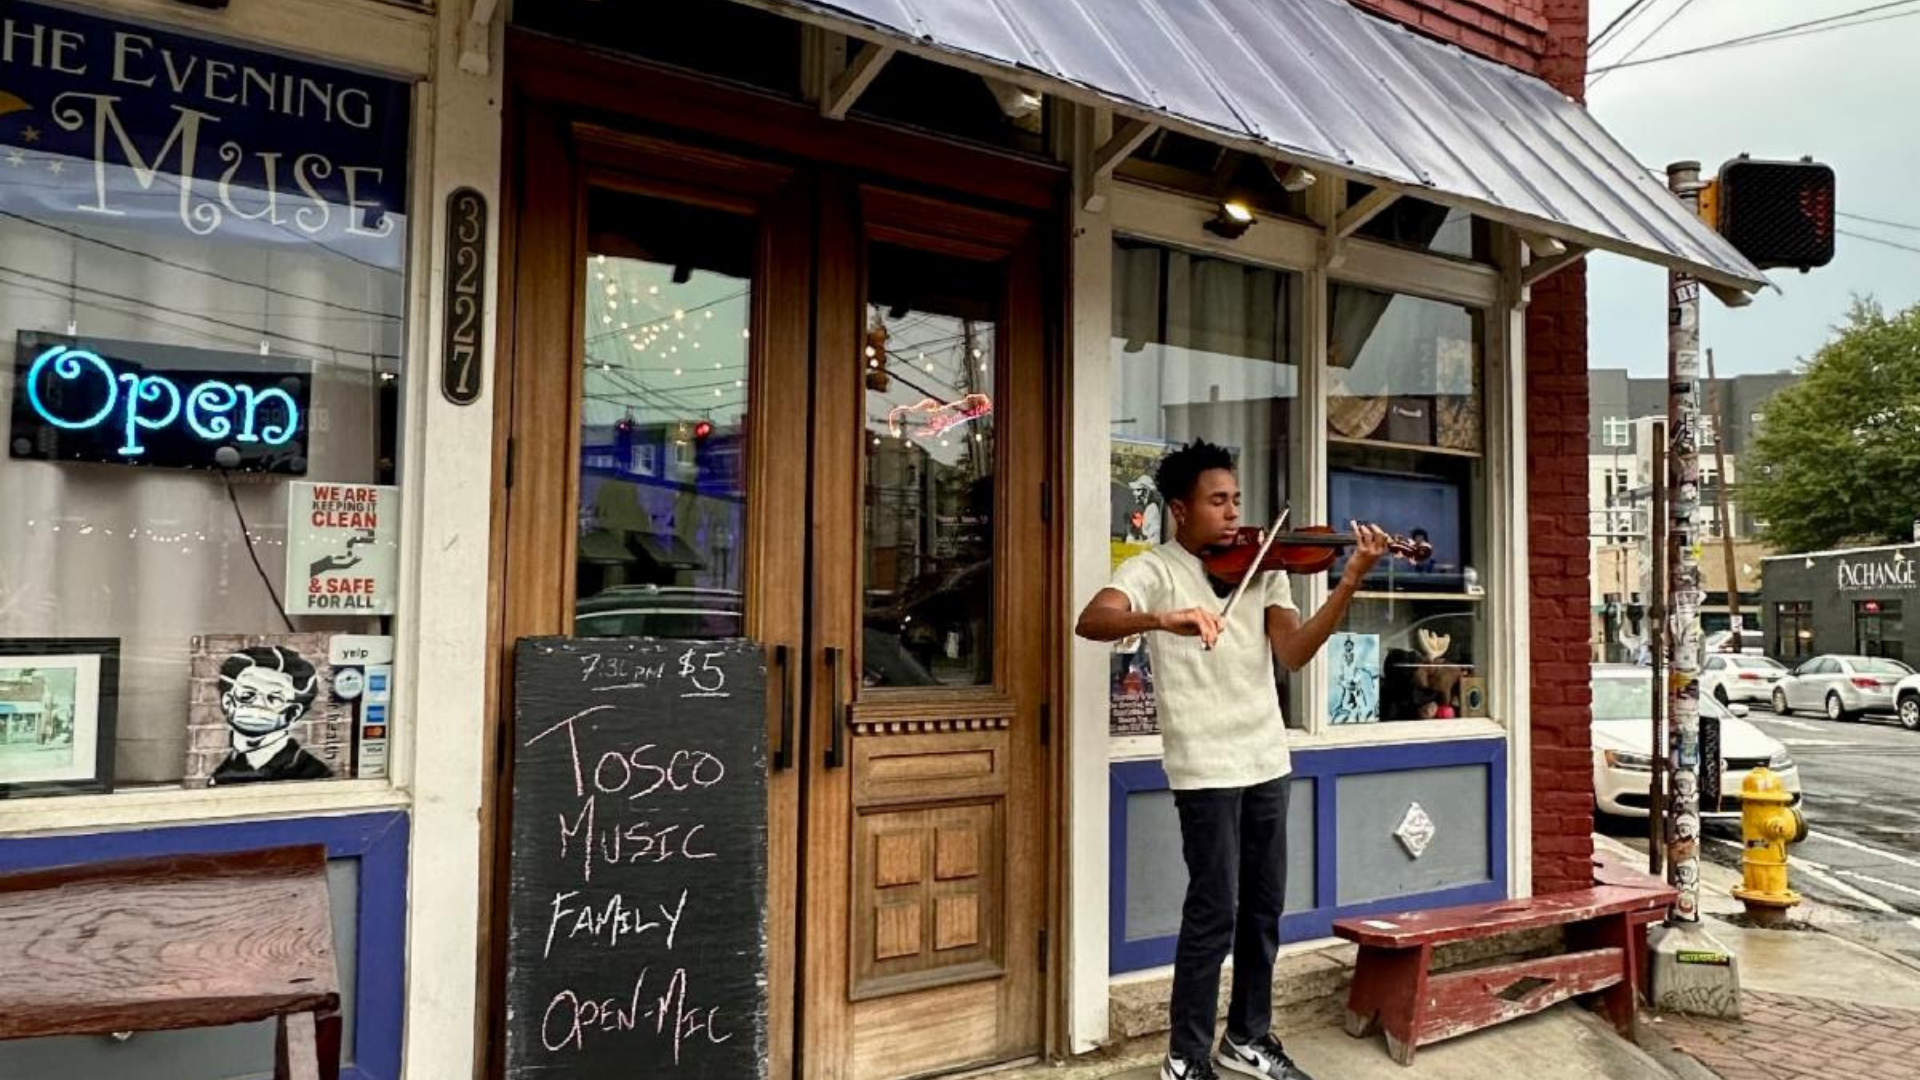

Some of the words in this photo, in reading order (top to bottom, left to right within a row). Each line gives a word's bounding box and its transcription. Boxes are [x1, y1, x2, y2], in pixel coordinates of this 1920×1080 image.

[2, 18, 87, 75] HE
[112, 31, 372, 129] EVENING
[51, 91, 395, 235] MUSE
[453, 196, 480, 394] 3227
[27, 345, 298, 455] Open
[312, 500, 364, 512] KEEPING
[367, 502, 377, 513] IT
[313, 486, 340, 501] WE
[344, 488, 377, 502] ARE
[311, 510, 377, 528] CLEAN
[308, 577, 322, 594] &
[326, 578, 374, 594] SAFE
[1838, 559, 1916, 588] EXCHANGE
[308, 595, 341, 609] FOR
[344, 596, 374, 609] ALL
[342, 647, 369, 660] yelp
[678, 648, 726, 691] $5
[524, 705, 724, 800] TOSCO
[559, 795, 716, 882] MUSIC
[543, 888, 688, 959] FAMILY
